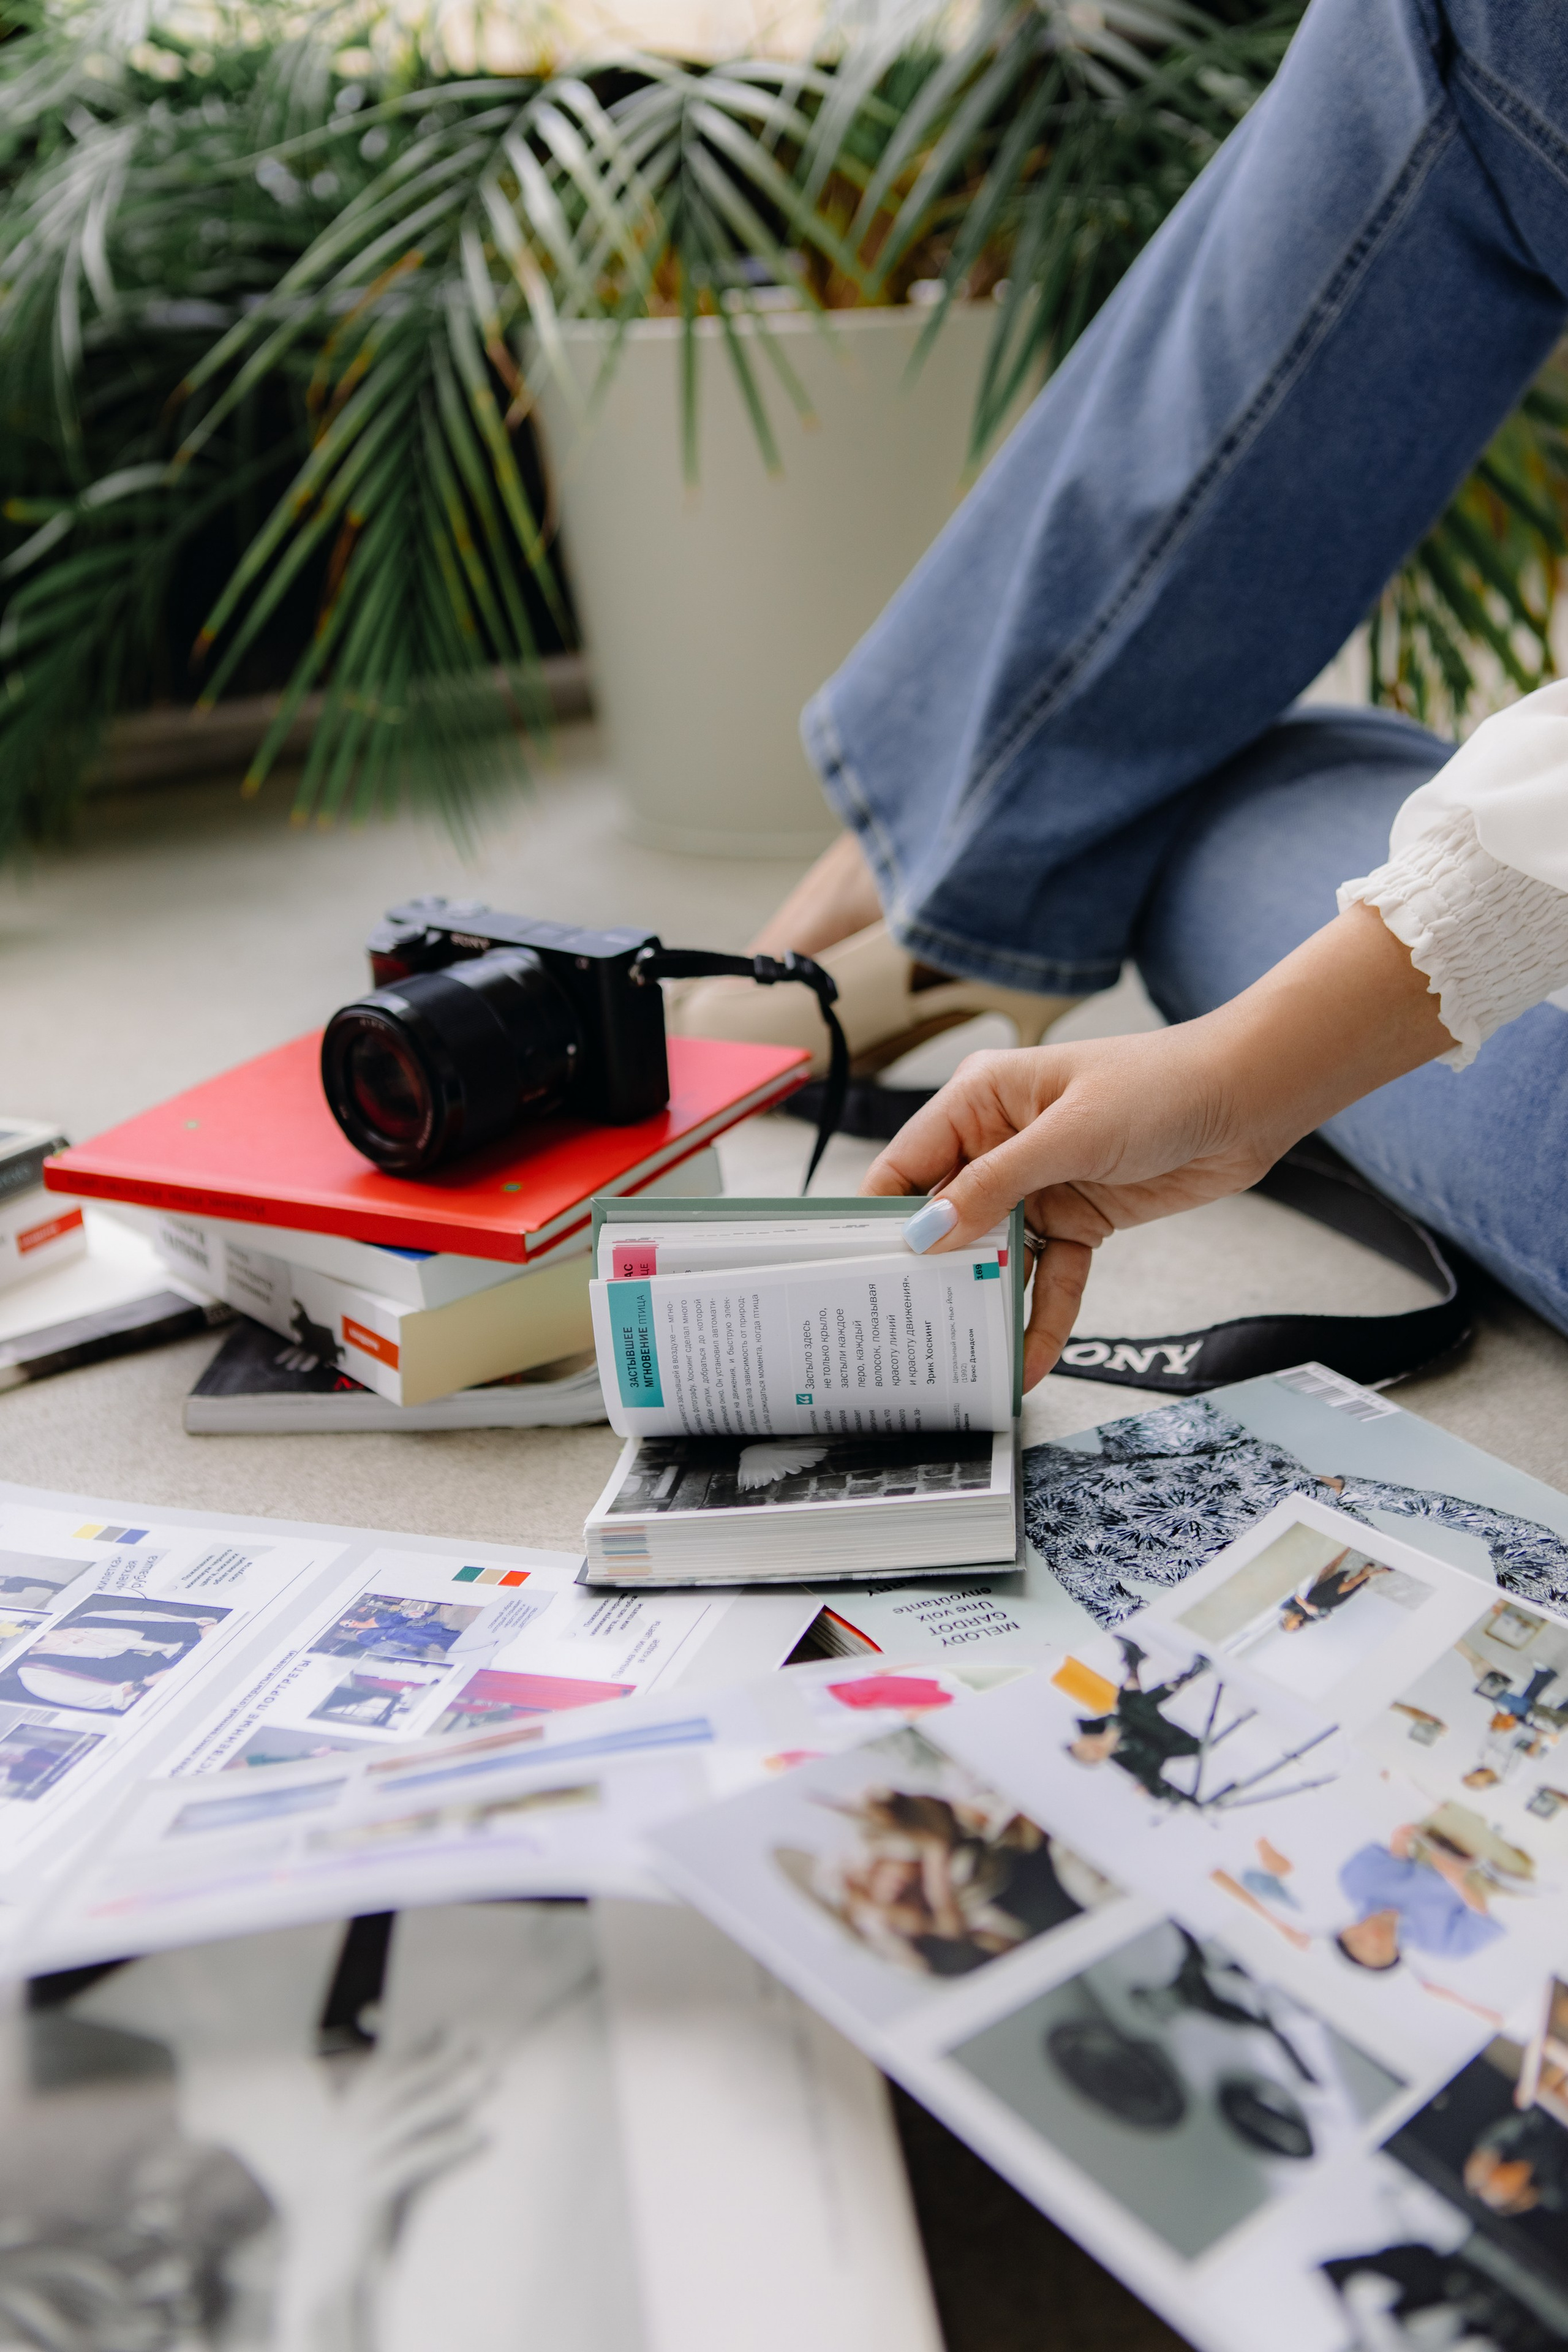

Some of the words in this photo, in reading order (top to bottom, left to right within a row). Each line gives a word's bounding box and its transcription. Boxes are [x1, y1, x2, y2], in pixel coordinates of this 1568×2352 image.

[636, 1295, 647, 1324] ПТИЦА
[680, 1300, 689, 1324] много
[695, 1299, 704, 1331] которой
[737, 1295, 747, 1327] природ-
[751, 1294, 760, 1318] птица
[868, 1284, 881, 1342] показывая
[902, 1276, 916, 1336] движения».
[945, 1287, 955, 1320] Нью-Йорк
[683, 1327, 692, 1352] сделал
[698, 1335, 706, 1344] до
[723, 1322, 735, 1355] быструю
[753, 1321, 762, 1342] когда
[802, 1321, 813, 1349] здесь
[818, 1308, 829, 1342] крыло,
[836, 1309, 846, 1348] каждое
[852, 1321, 864, 1360] каждый
[887, 1315, 898, 1346] линий
[924, 1321, 934, 1359] Хоскинг
[623, 1327, 639, 1388] ЗАСТЫВШЕЕ
[638, 1327, 654, 1388] МГНОВЕНИЕ
[669, 1335, 679, 1363] воздухе
[714, 1341, 724, 1377] установил
[755, 1345, 765, 1378] момента,
[821, 1346, 831, 1376] только
[906, 1339, 918, 1378] красоту
[951, 1341, 959, 1383] Центральный
[968, 1329, 976, 1363] Дэвидсон
[1061, 1341, 1204, 1374] ONY
[685, 1355, 695, 1381] Хоскинг
[699, 1348, 710, 1383] добраться
[741, 1341, 752, 1386] зависимость
[804, 1352, 815, 1389] Застыло
[839, 1351, 849, 1389] застыли
[856, 1363, 866, 1387] перо,
[872, 1346, 883, 1387] волосок,
[889, 1349, 900, 1386] красоту
[927, 1362, 935, 1384] Эрик
[673, 1371, 684, 1403] застывшей
[688, 1384, 701, 1412] фотографу.
[704, 1387, 714, 1407] сипухи,
[729, 1367, 740, 1400] движения,
[745, 1389, 755, 1407] отпала
[758, 1381, 769, 1413] дожидаться
[823, 1379, 832, 1389] не
[131, 1556, 158, 1588] рубашка
[619, 1620, 630, 1630] или
[627, 1603, 644, 1621] платье
[892, 1586, 992, 1615] envoûtante
[917, 1610, 955, 1623] voix
[957, 1600, 994, 1613] Une
[589, 1611, 612, 1636] минимум
[927, 1611, 1008, 1637] GARDOT
[941, 1621, 1021, 1648] MELODY
[611, 1653, 636, 1679] Пальма
[633, 1640, 646, 1654] или
[642, 1620, 662, 1640] цветы
[641, 1639, 660, 1658] кадре
[236, 1672, 275, 1709] (открытые
[271, 1649, 298, 1672] плечи)
[255, 1659, 312, 1711] ПОРТРЕТЫ
